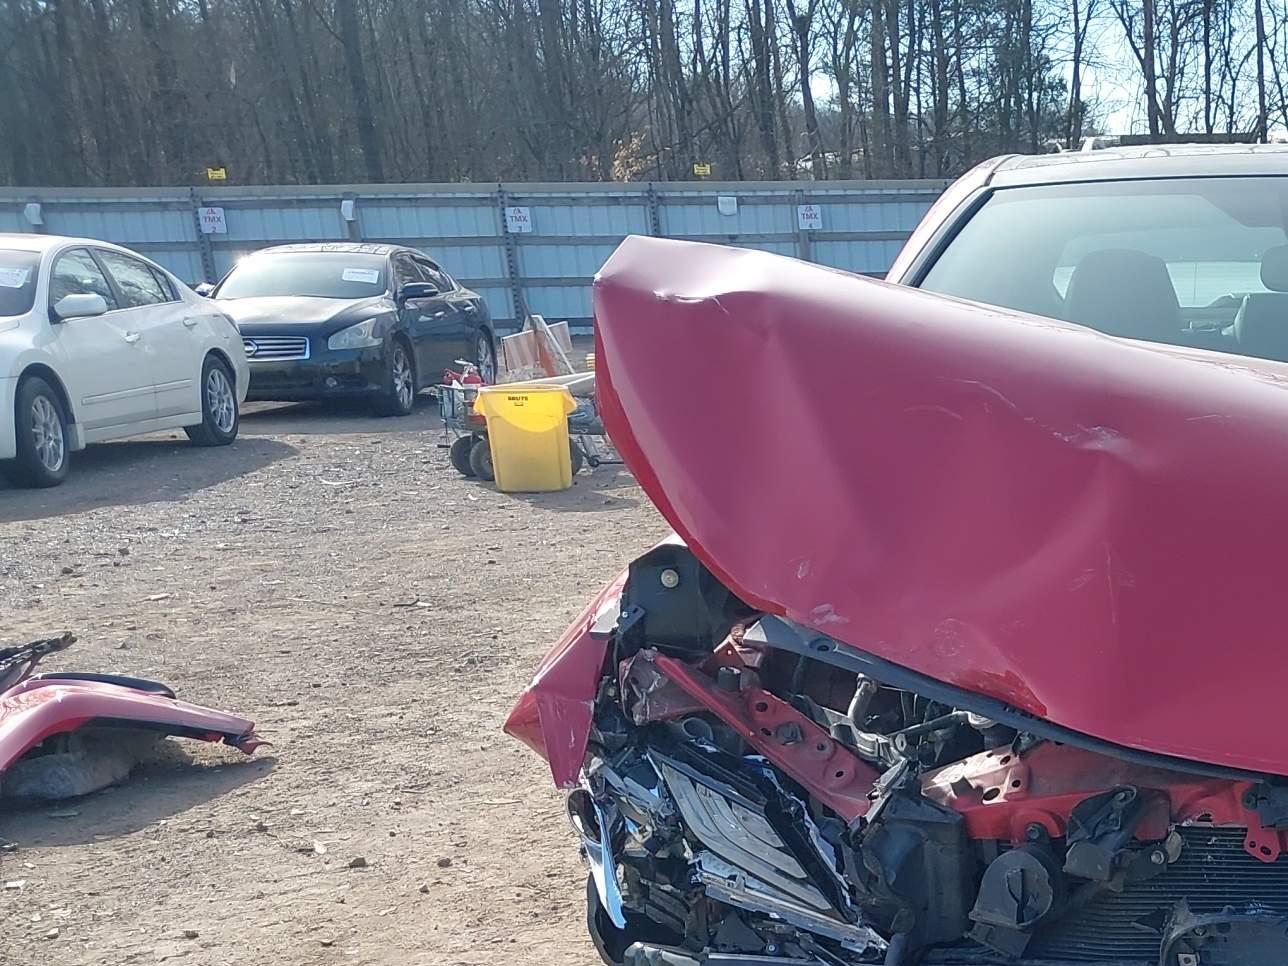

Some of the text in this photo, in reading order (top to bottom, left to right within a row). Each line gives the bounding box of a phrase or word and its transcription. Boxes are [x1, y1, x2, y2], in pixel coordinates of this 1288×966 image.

[202, 215, 222, 223] TMX
[510, 215, 528, 223] TMX
[800, 212, 819, 220] TMX
